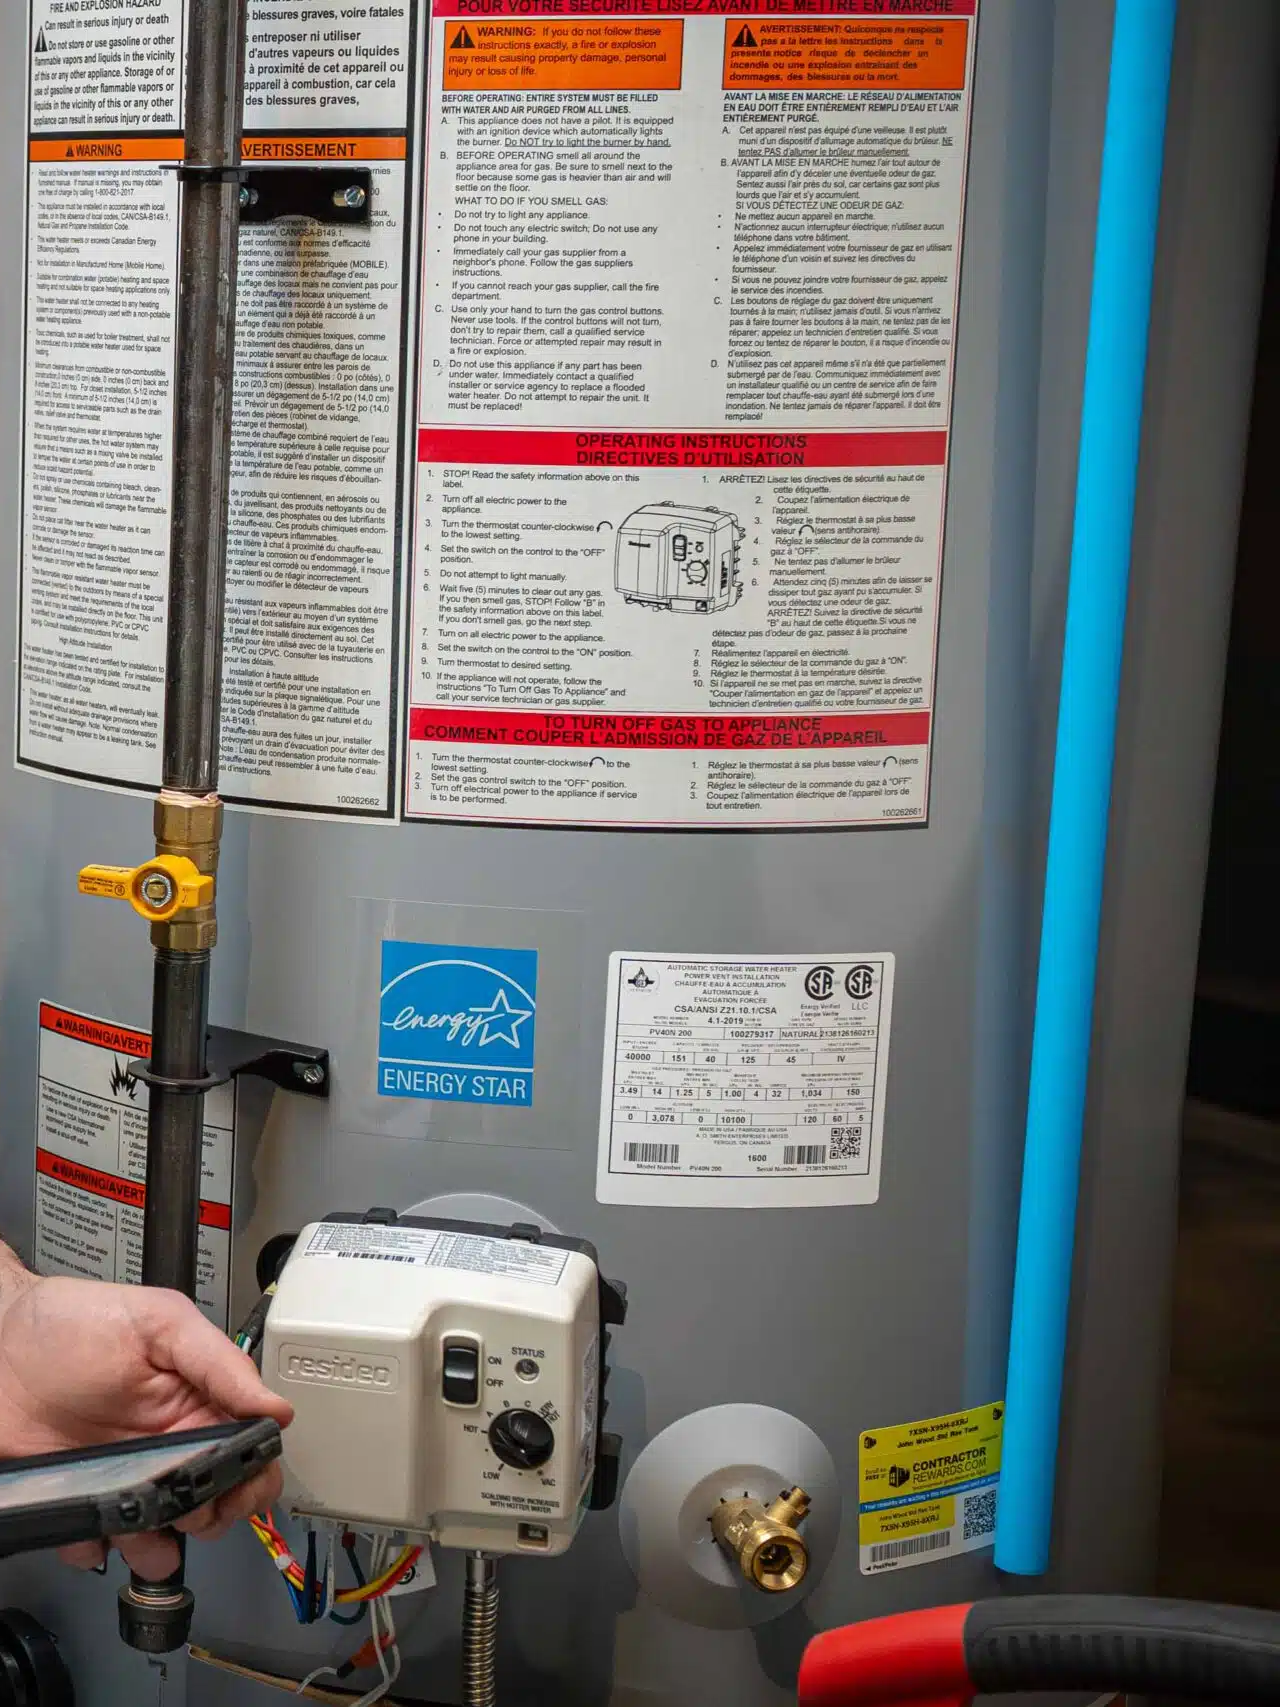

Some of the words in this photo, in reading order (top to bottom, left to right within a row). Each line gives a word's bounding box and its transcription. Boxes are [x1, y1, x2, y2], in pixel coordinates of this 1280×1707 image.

[50, 3, 63, 13] FIRE
[65, 2, 79, 12] AND
[81, 0, 123, 11] EXPLOSION
[457, 0, 501, 13] POUR
[510, 0, 563, 12] VOTRE
[656, 0, 701, 12] LISEZ
[710, 0, 764, 12] AVANT
[770, 0, 789, 11] DE
[794, 0, 857, 11] METTRE
[863, 0, 883, 11] EN
[889, 0, 952, 12] MARCHE
[253, 10, 298, 20] blessures
[301, 11, 337, 21] graves,
[341, 8, 366, 18] voire
[370, 7, 404, 17] fatales
[45, 21, 56, 30] Can
[57, 19, 74, 29] result
[76, 19, 82, 28] in
[84, 17, 109, 28] serious
[112, 15, 133, 28] injury
[136, 17, 143, 25] or
[146, 14, 169, 24] death
[252, 32, 307, 44] entreposer
[310, 31, 320, 40] ni
[324, 30, 361, 41] utiliser
[477, 26, 536, 37] WARNING:
[543, 27, 549, 36] If
[552, 28, 568, 39] you
[571, 27, 583, 36] do
[586, 28, 600, 36] not
[604, 26, 631, 36] follow
[635, 26, 661, 36] these
[478, 40, 530, 50] instructions
[534, 40, 568, 52] exactly,
[581, 39, 596, 49] fire
[599, 41, 608, 49] or
[611, 40, 656, 51] explosion
[249, 48, 289, 58] d'autres
[292, 47, 334, 60] vapeurs
[338, 48, 351, 56] ou
[355, 46, 399, 60] liquides
[449, 55, 468, 64] may
[471, 53, 496, 63] result
[499, 54, 536, 64] causing
[538, 53, 577, 64] property
[580, 53, 622, 64] damage,
[625, 53, 666, 64] personal
[249, 64, 254, 74] à
[258, 63, 304, 76] proximité
[308, 63, 320, 73] de
[324, 64, 339, 72] cet
[343, 62, 386, 75] appareil
[390, 64, 404, 72] ou
[448, 67, 472, 77] injury
[476, 67, 485, 75] or
[488, 66, 506, 75] loss
[510, 66, 519, 75] of
[521, 66, 536, 75] life.
[284, 79, 288, 89] à
[292, 79, 352, 91] combustion,
[356, 79, 370, 88] car
[375, 77, 396, 88] cela
[76, 144, 122, 156] WARNING
[455, 197, 481, 205] WHAT
[485, 197, 497, 205] TO
[500, 197, 514, 205] DO
[517, 197, 526, 205] IF
[528, 197, 547, 205] YOU
[551, 197, 582, 205] SMELL
[585, 197, 608, 205] GAS:
[576, 435, 675, 449] OPERATING
[682, 435, 807, 449] INSTRUCTIONS
[577, 452, 679, 466] DIRECTIVES
[685, 452, 805, 466] D'UTILISATION
[543, 716, 563, 729] TO
[570, 716, 618, 730] TURN
[622, 717, 655, 731] OFF
[661, 717, 697, 731] GAS
[703, 717, 723, 731] TO
[729, 717, 822, 731] APPLIANCE
[425, 725, 509, 741] COMMENT
[514, 728, 585, 744] COUPER
[591, 730, 698, 746] L'ADMISSION
[704, 731, 726, 746] DE
[731, 732, 765, 746] GAZ
[771, 732, 793, 746] DE
[799, 731, 887, 746] L'APPAREIL
[337, 795, 379, 806] 100262662
[675, 1006, 718, 1014] CSA/ANSI
[382, 1006, 498, 1046] energy
[707, 1017, 743, 1025] 4.1-2019
[62, 1019, 152, 1054] WARNING/AVERT
[384, 1069, 467, 1094] ENERGY
[472, 1076, 526, 1099] STAR
[620, 1087, 637, 1095] 3.49
[721, 1116, 745, 1124] 10100
[512, 1347, 544, 1358] STATUS
[488, 1356, 502, 1365] ON
[288, 1355, 390, 1386] resideo
[486, 1379, 503, 1387] OFF
[464, 1424, 478, 1433] HOT
[913, 1447, 986, 1471] CONTRACTOR
[483, 1471, 499, 1480] LOW
[913, 1458, 986, 1484] REWARDS.COM
[541, 1478, 555, 1487] VAC
